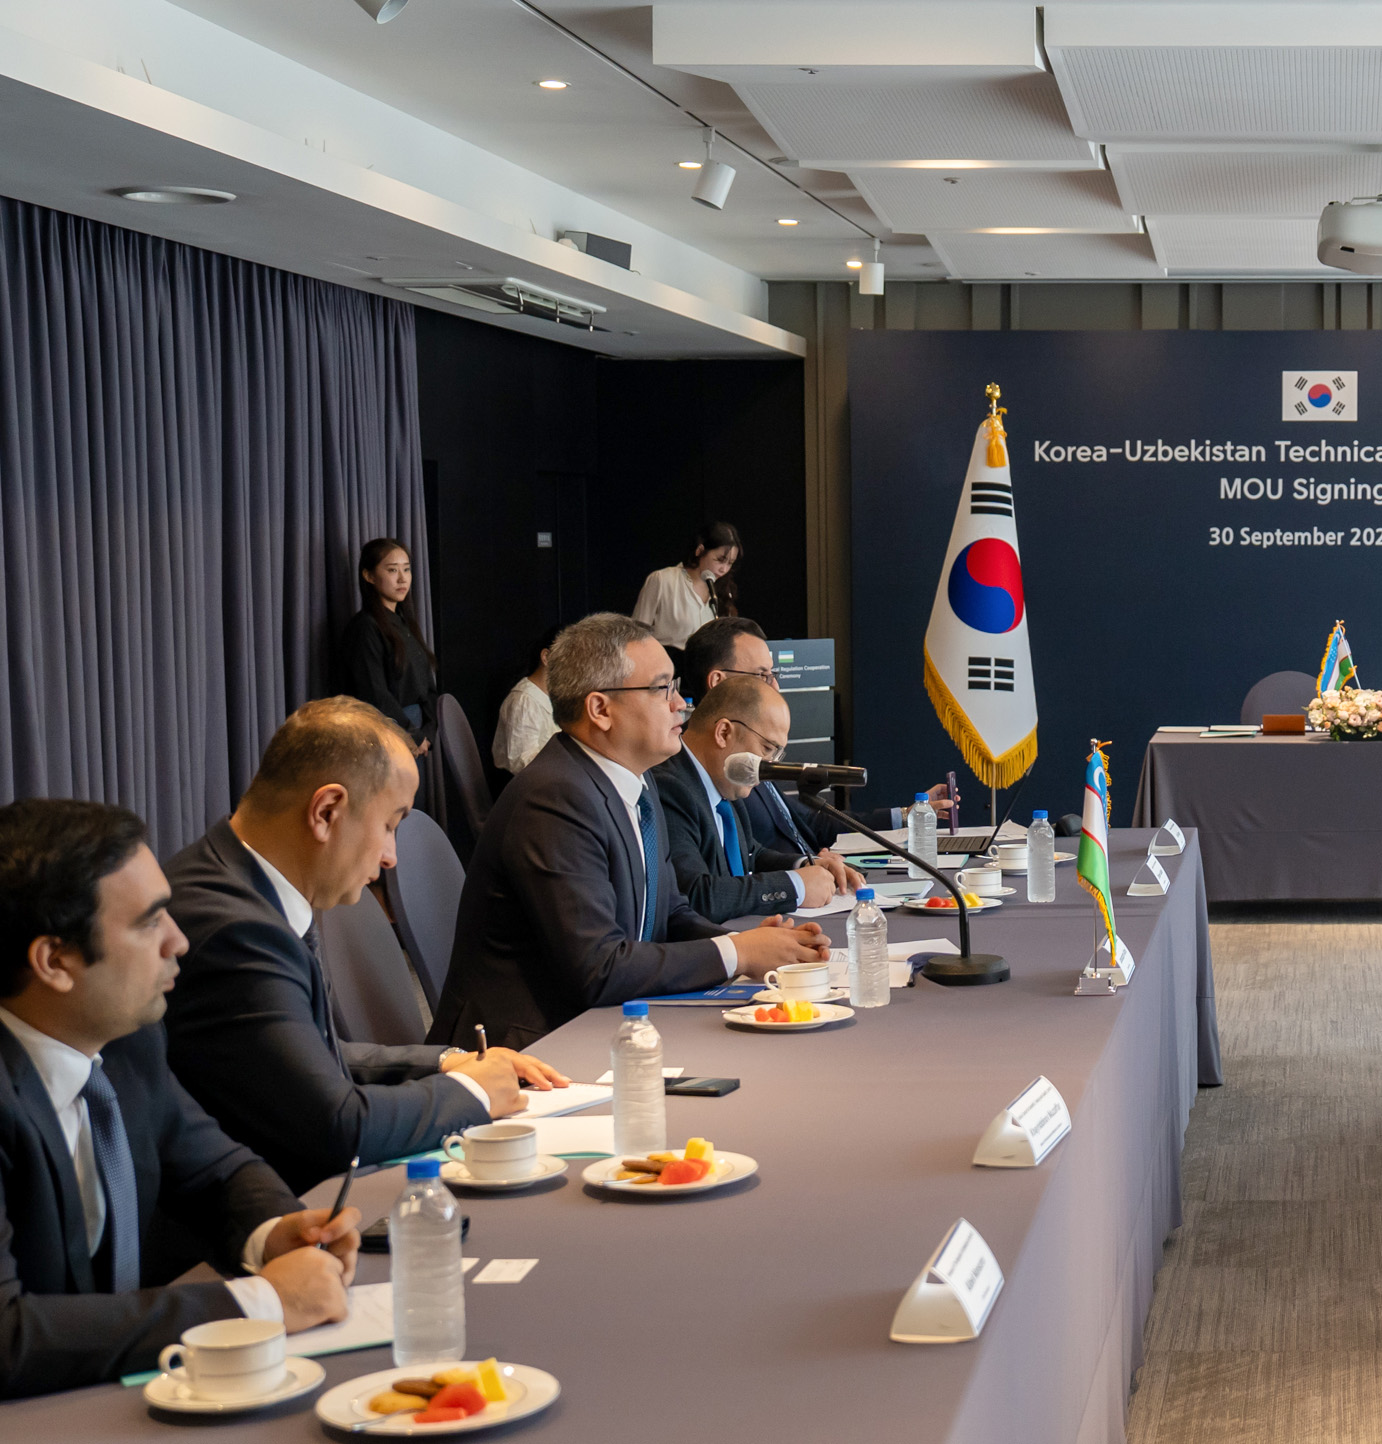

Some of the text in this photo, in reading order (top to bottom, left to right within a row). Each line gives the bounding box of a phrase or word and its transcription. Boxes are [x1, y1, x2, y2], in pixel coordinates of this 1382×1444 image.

[1033, 438, 1267, 463] Korea-Uzbekistan
[1219, 477, 1284, 501] MOU
[1209, 526, 1234, 546] 30
[1240, 526, 1345, 549] September
